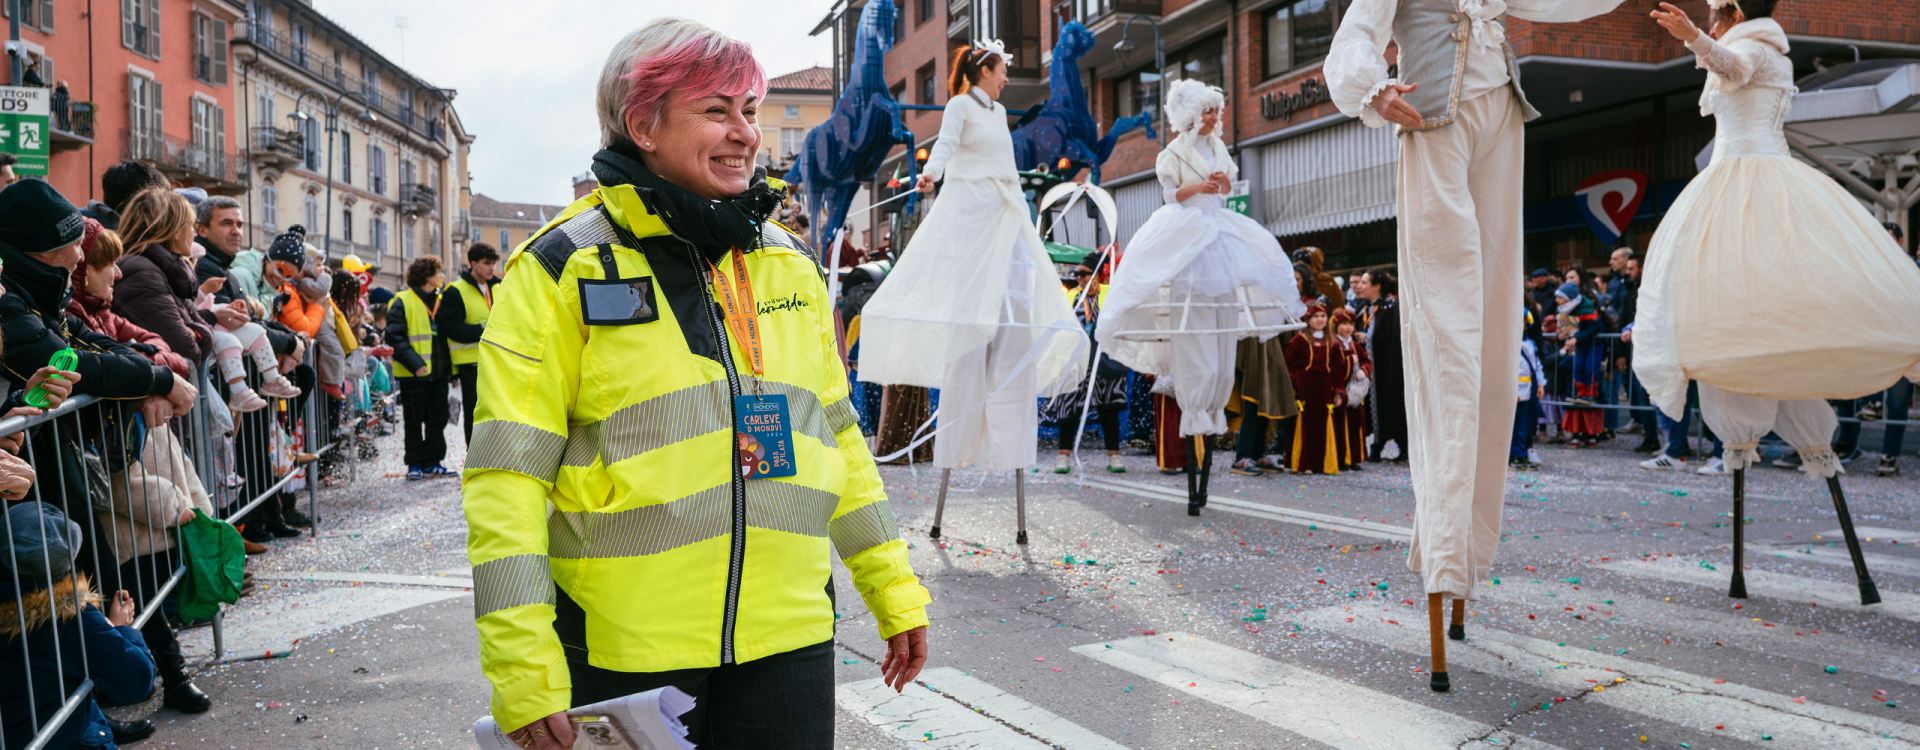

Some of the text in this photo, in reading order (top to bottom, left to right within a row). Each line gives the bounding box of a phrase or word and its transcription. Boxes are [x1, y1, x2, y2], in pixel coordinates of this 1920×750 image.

[0, 90, 39, 99] TTORE
[2, 99, 28, 112] D9
[772, 451, 781, 468] PASS
[778, 440, 790, 469] SFILATA
